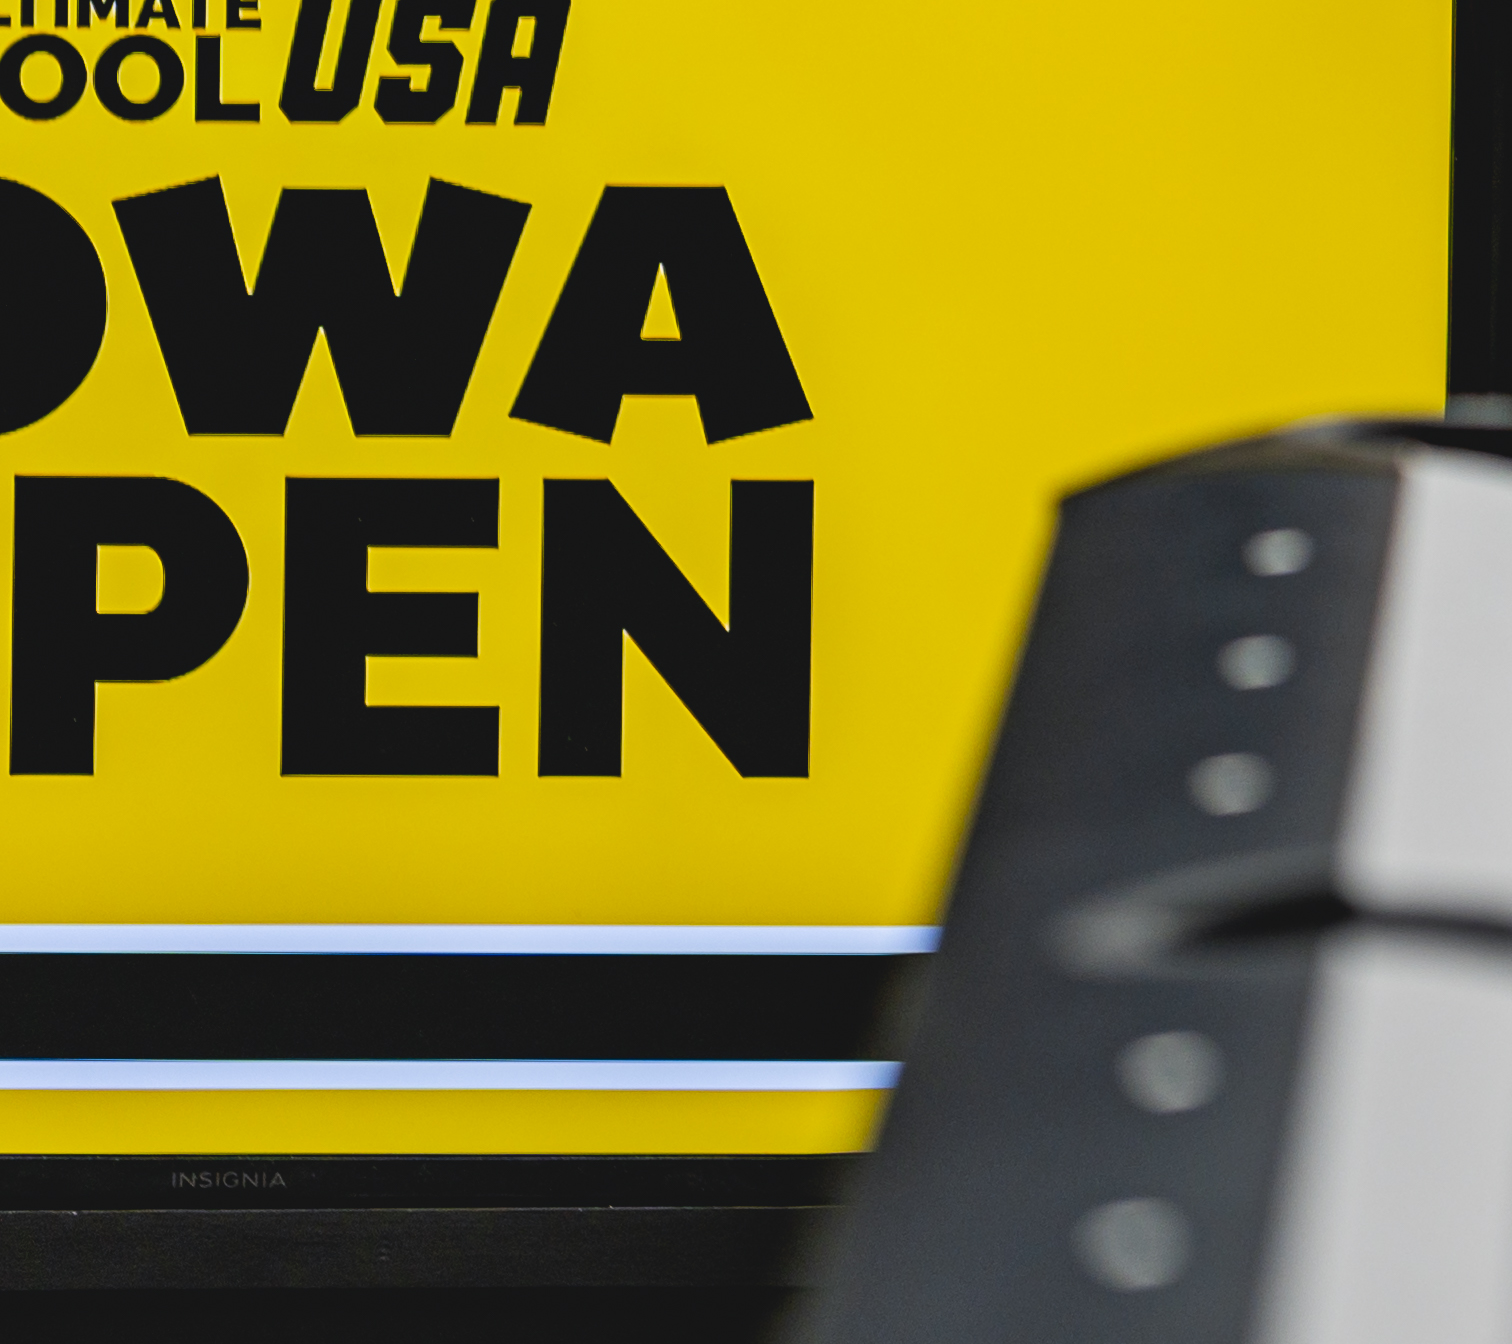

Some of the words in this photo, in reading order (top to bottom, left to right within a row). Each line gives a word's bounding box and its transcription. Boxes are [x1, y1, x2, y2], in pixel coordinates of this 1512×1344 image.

[0, 33, 261, 122] OOL
[9, 475, 815, 779] PEN
[171, 1171, 288, 1189] INSIGNIA
